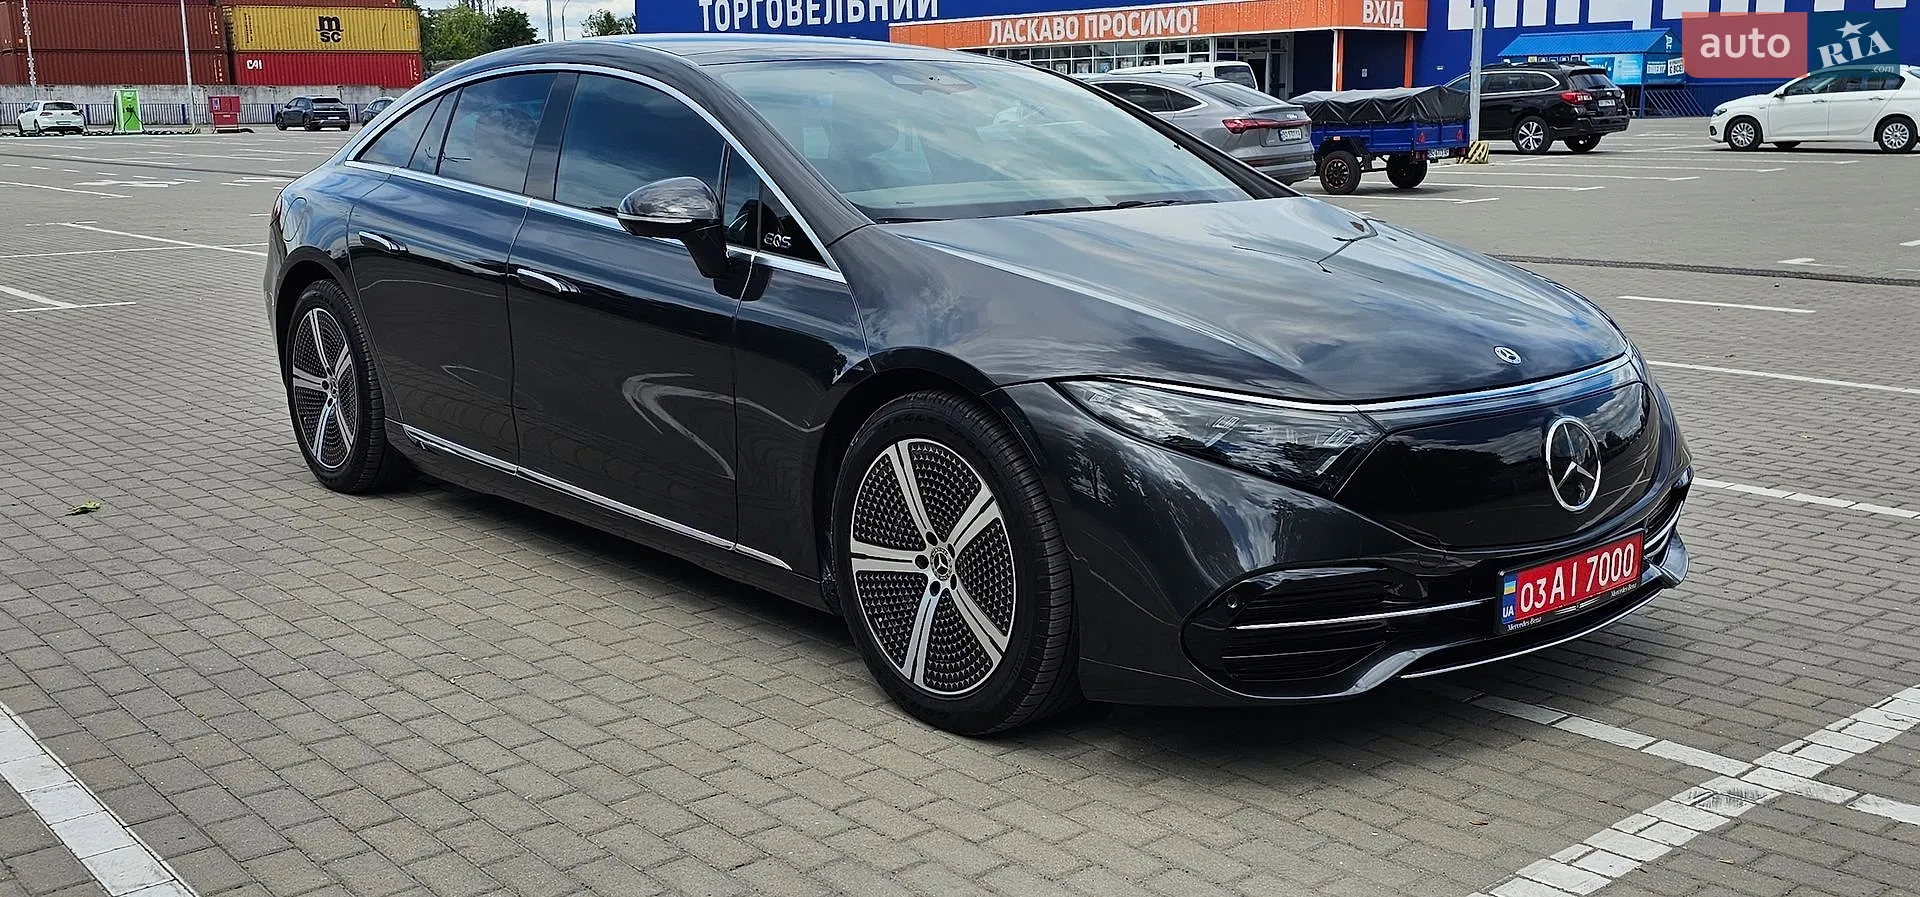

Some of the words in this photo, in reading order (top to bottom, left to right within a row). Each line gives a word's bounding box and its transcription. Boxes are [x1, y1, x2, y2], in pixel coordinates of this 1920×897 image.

[1362, 0, 1404, 28] ВХІД
[989, 15, 1079, 44] ЛАСКАВО
[1084, 8, 1199, 39] ПРОСИМО!
[246, 59, 263, 70] CAI
[763, 232, 792, 249] EQS
[1586, 543, 1635, 592] 7000
[1502, 605, 1514, 618] UA
